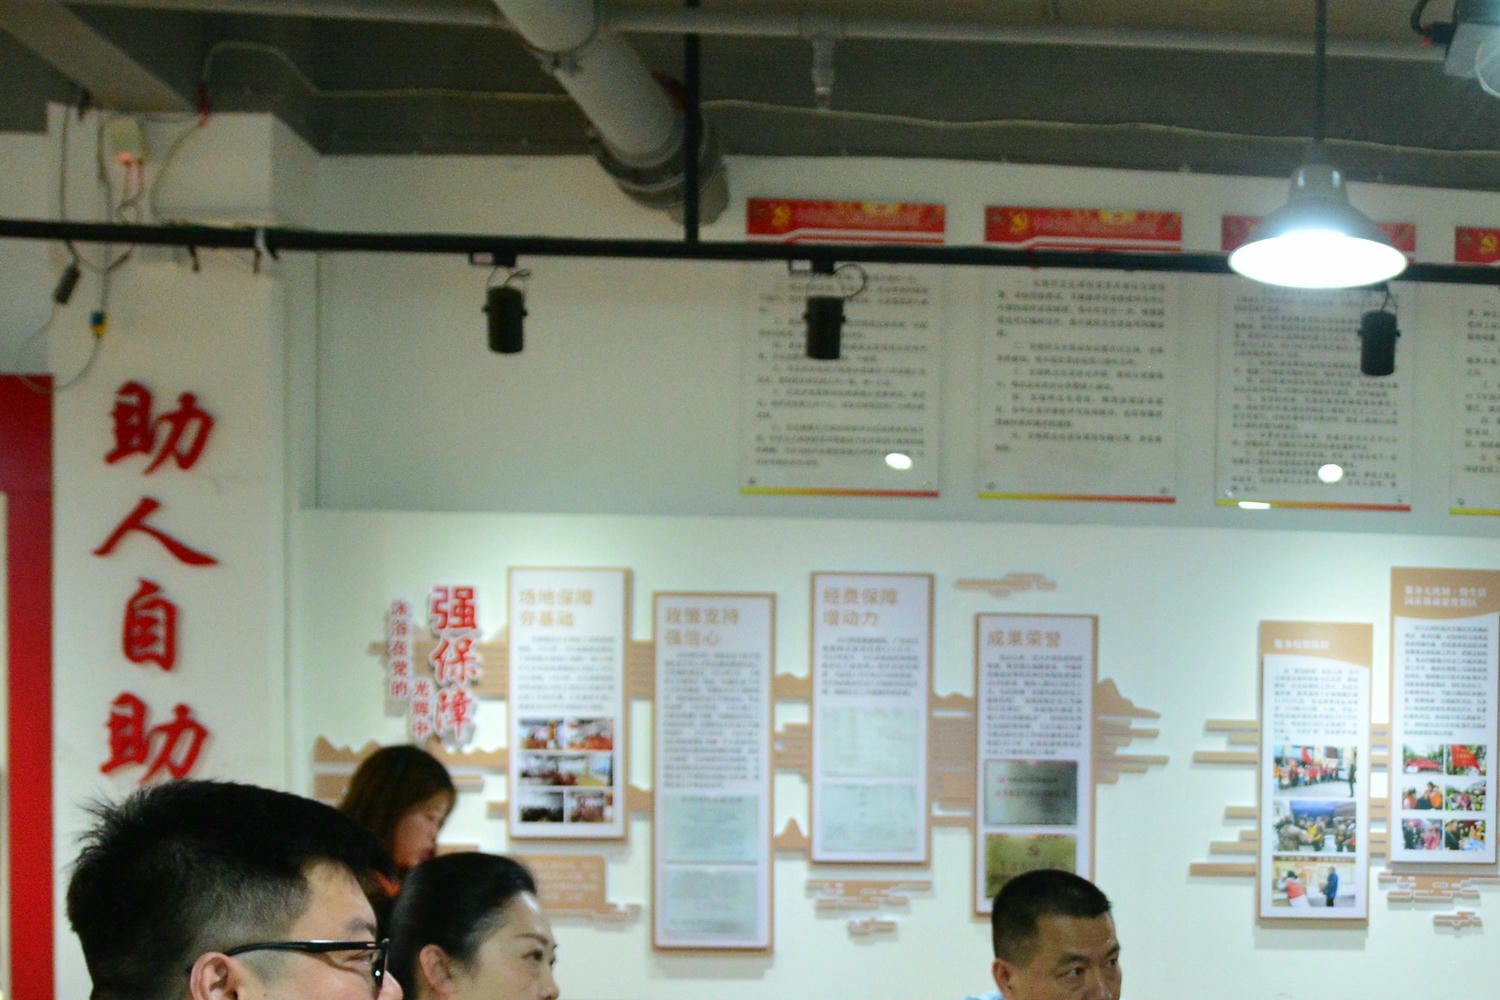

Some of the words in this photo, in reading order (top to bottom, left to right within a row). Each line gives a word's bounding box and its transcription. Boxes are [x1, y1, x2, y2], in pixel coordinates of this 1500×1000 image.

[91, 379, 220, 782] 助人自助
[431, 584, 479, 740] 强保障
